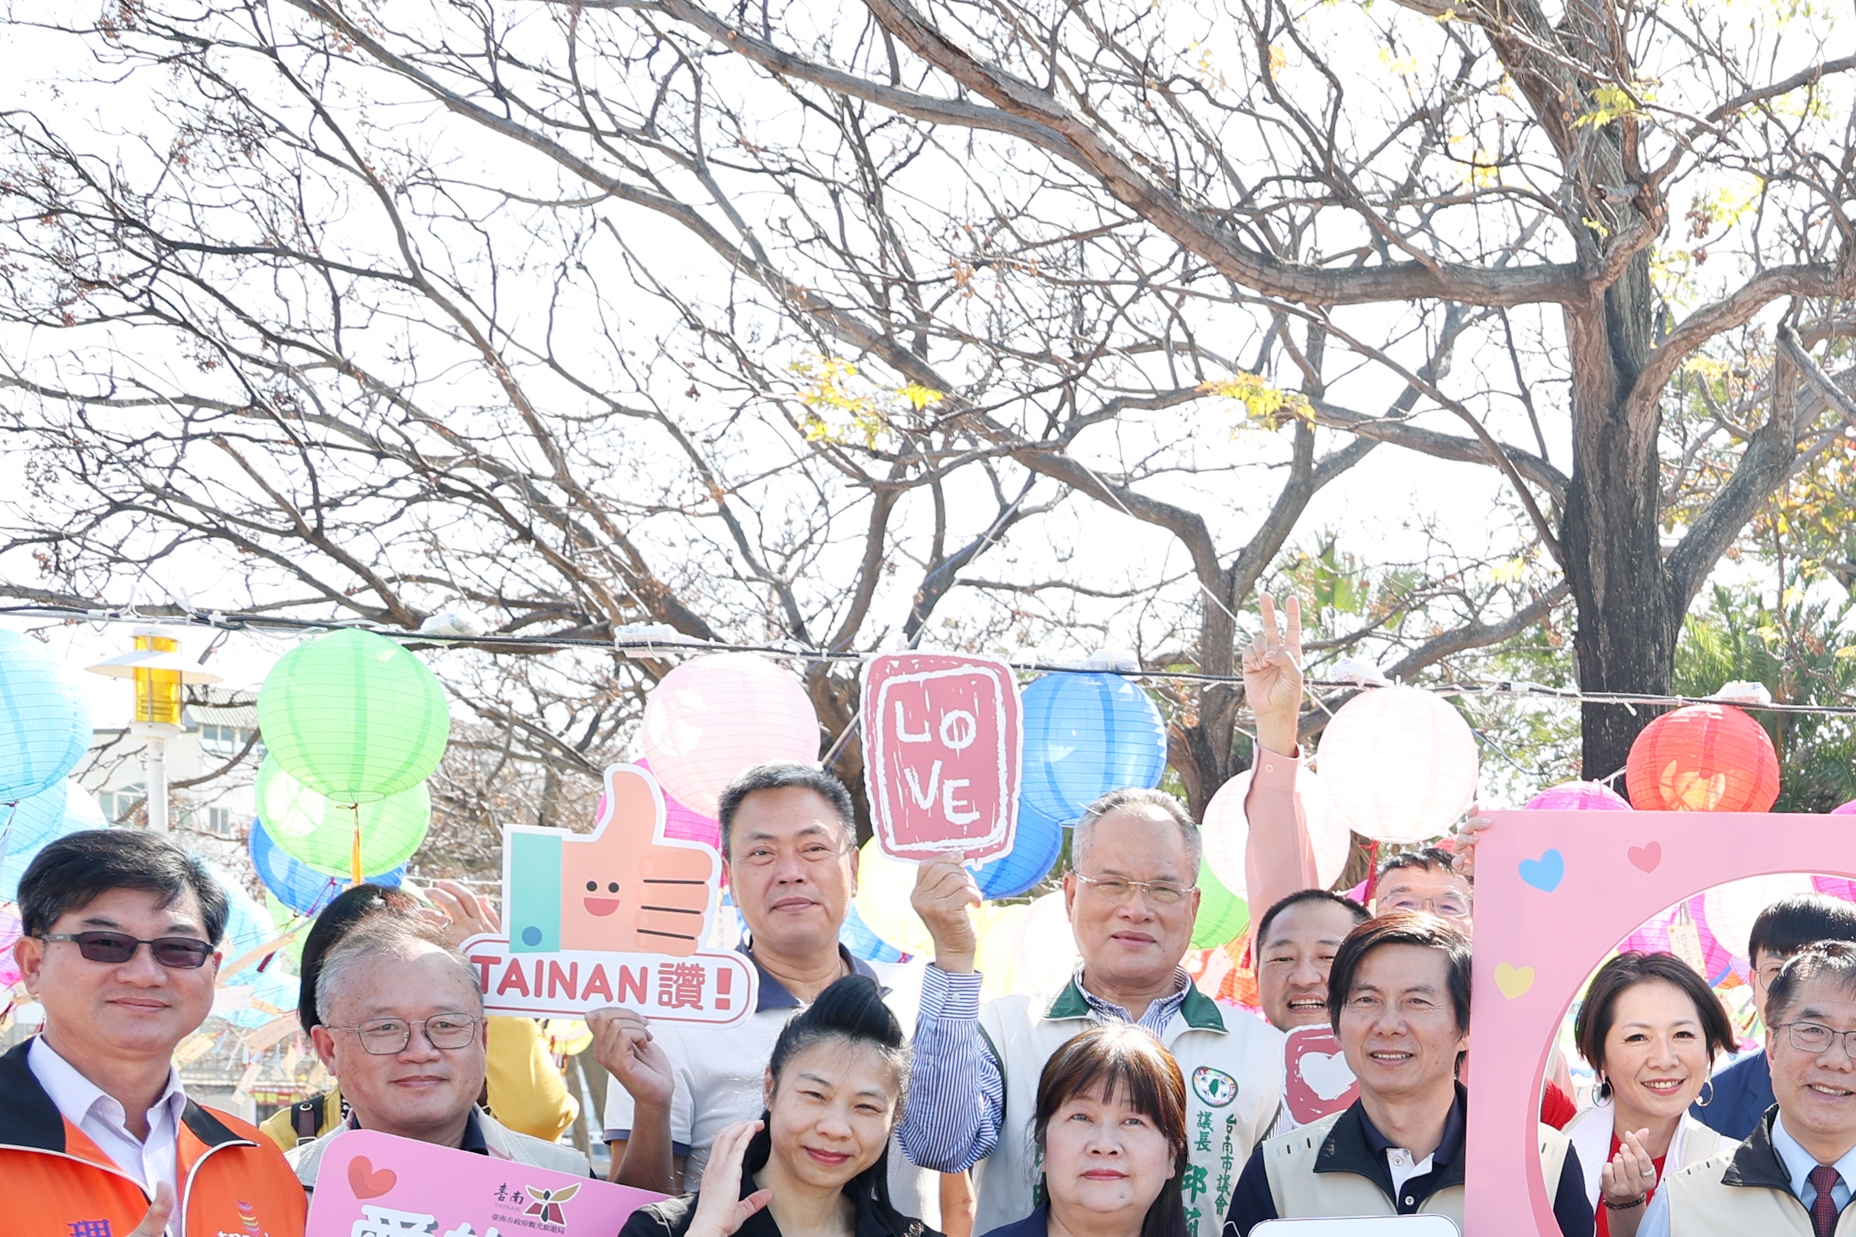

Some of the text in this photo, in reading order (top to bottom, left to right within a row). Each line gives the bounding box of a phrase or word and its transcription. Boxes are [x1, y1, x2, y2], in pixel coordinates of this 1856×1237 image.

[470, 955, 648, 1005] TAINAN
[1194, 1110, 1214, 1152] 議長
[1214, 1113, 1237, 1216] 台南市議會
